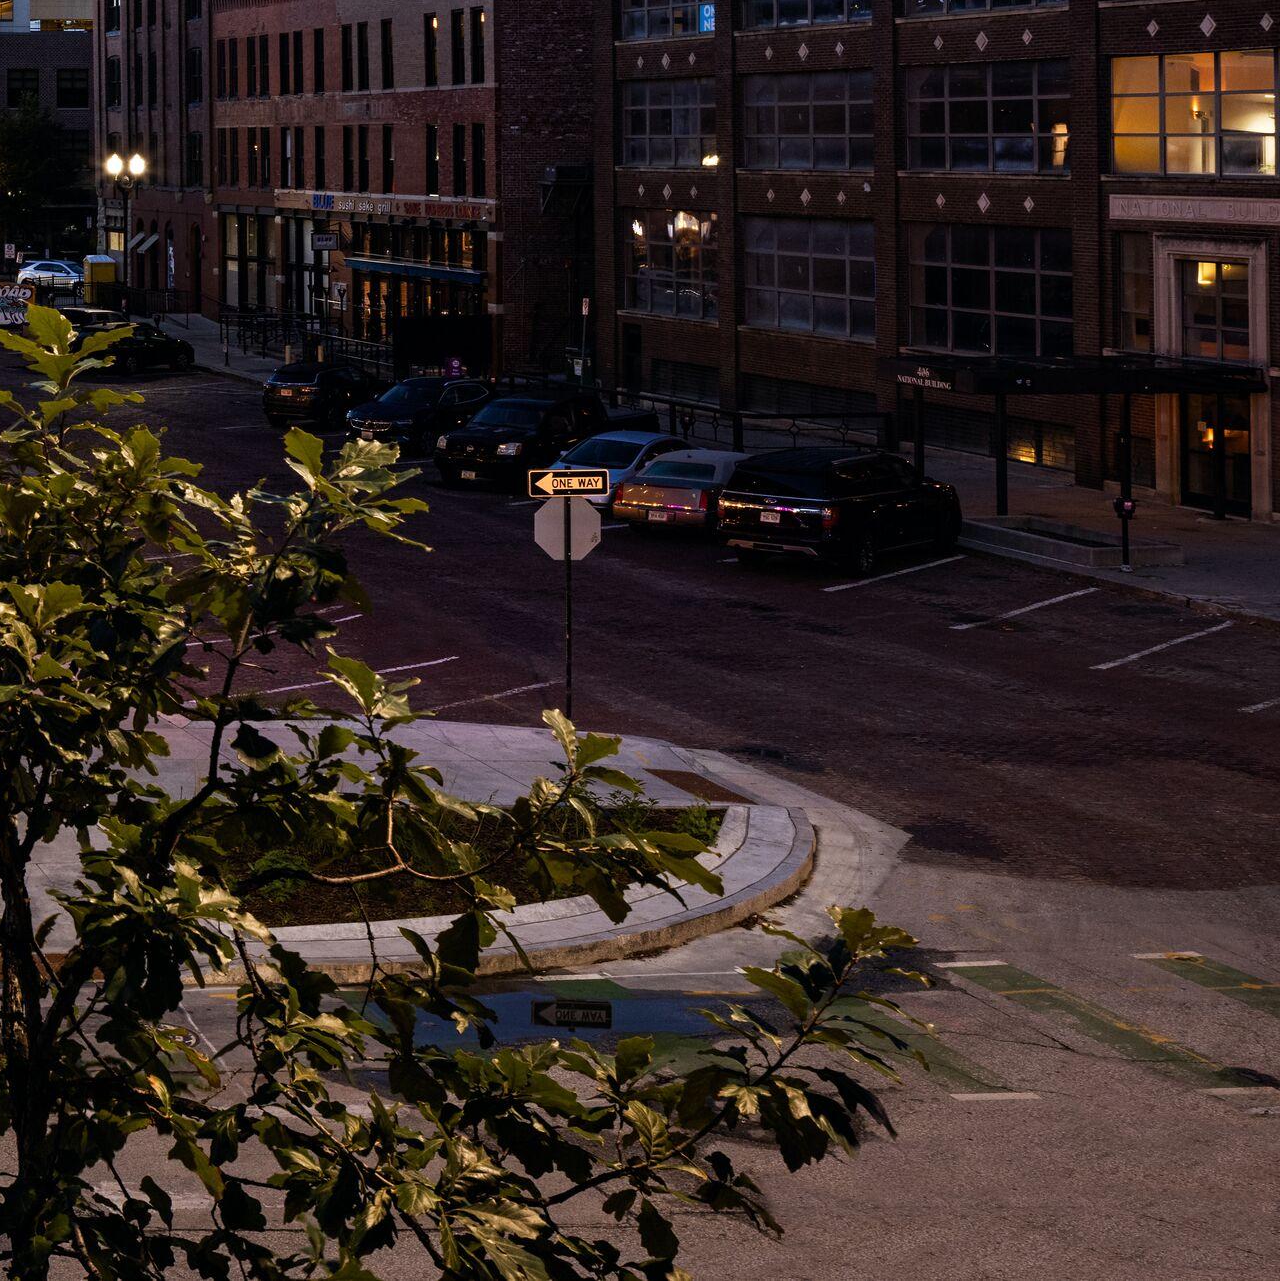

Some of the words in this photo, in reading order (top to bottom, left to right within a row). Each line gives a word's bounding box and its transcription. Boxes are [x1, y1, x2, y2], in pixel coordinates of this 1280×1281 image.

[312, 194, 334, 209] BLUE
[1120, 199, 1207, 218] NATIONAL
[897, 374, 925, 387] NATIONAL
[924, 379, 952, 390] BUILDING
[551, 478, 573, 489] ONE
[578, 477, 600, 488] WAY
